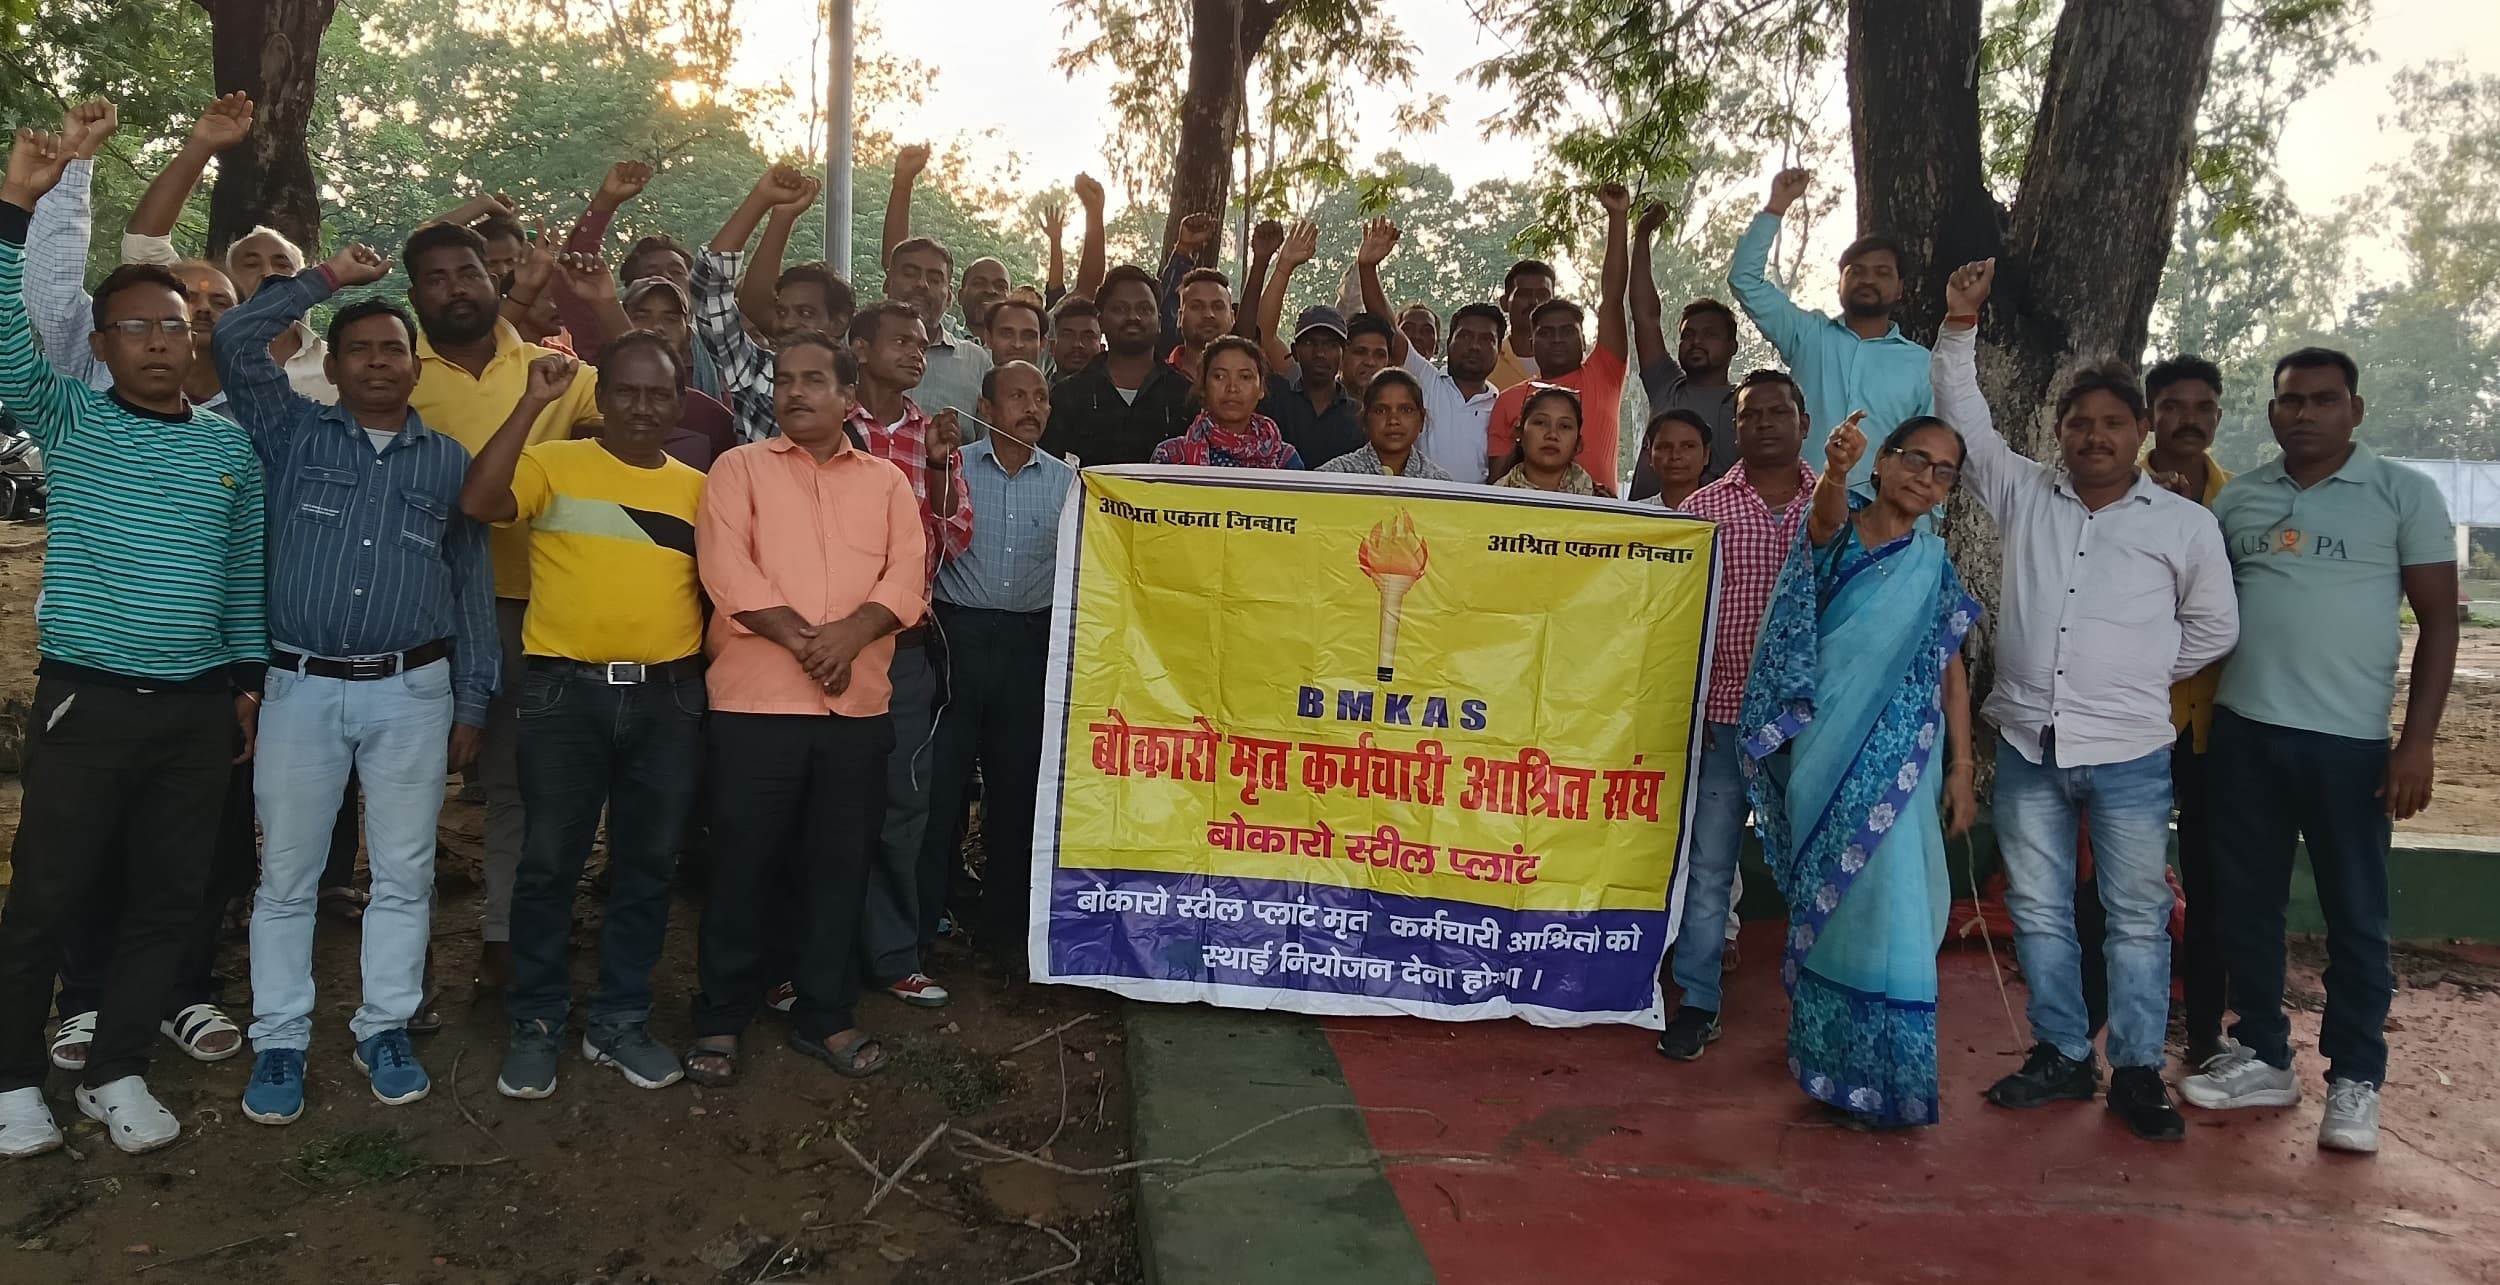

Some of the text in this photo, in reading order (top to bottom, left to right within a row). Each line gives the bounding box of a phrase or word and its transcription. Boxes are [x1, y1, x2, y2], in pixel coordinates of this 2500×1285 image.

[1163, 509, 1220, 528] एकता
[1488, 534, 1560, 555] आश्रित
[1564, 541, 1623, 558] एकता
[2312, 536, 2348, 559] PA
[1297, 686, 1487, 730] BMKAS
[1089, 708, 1666, 822] बोकारो मृत कर्मचारी आश्रित संघ
[1207, 812, 1541, 884] बोकारो स्टील प्लांट
[1077, 882, 1170, 916] बोकारो
[1176, 888, 1247, 921] स्टील
[1252, 896, 1319, 926] प्लांट
[1323, 906, 1372, 940] मृत
[1389, 909, 1502, 950] कर्मचारी
[1605, 923, 1643, 951] को
[1202, 941, 1274, 976] स्थाई
[1279, 942, 1395, 982] नियोजन
[1401, 954, 1455, 989] देना
